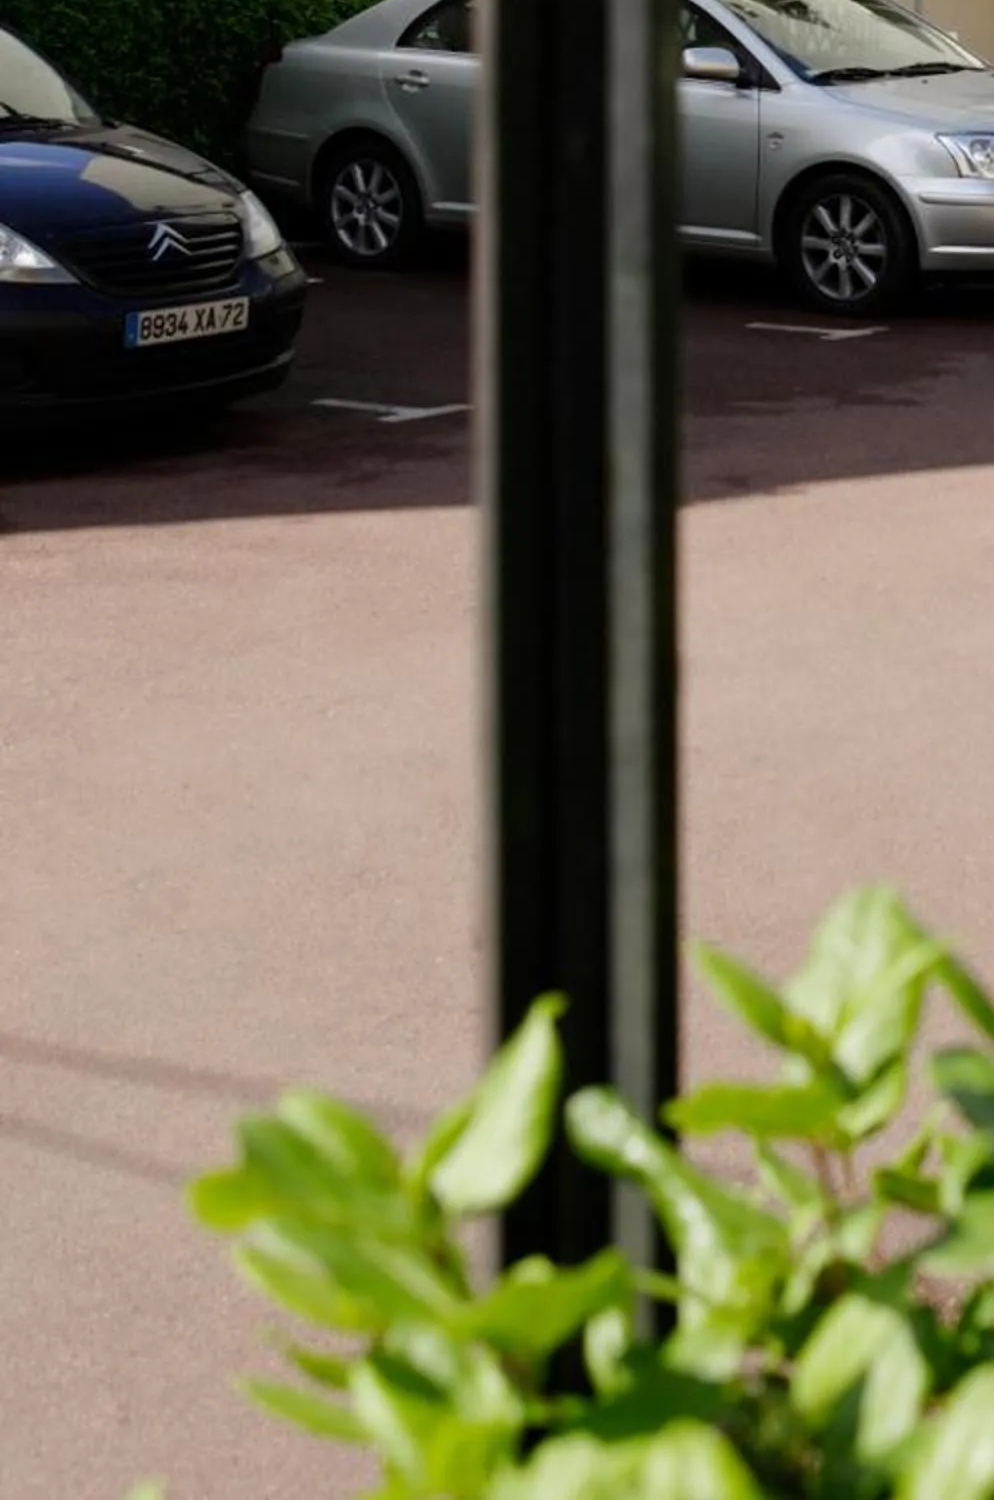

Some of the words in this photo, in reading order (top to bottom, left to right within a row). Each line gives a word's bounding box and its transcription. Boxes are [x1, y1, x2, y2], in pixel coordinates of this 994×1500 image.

[140, 311, 189, 340] 8934
[193, 306, 217, 332] XA
[221, 302, 245, 327] 72
